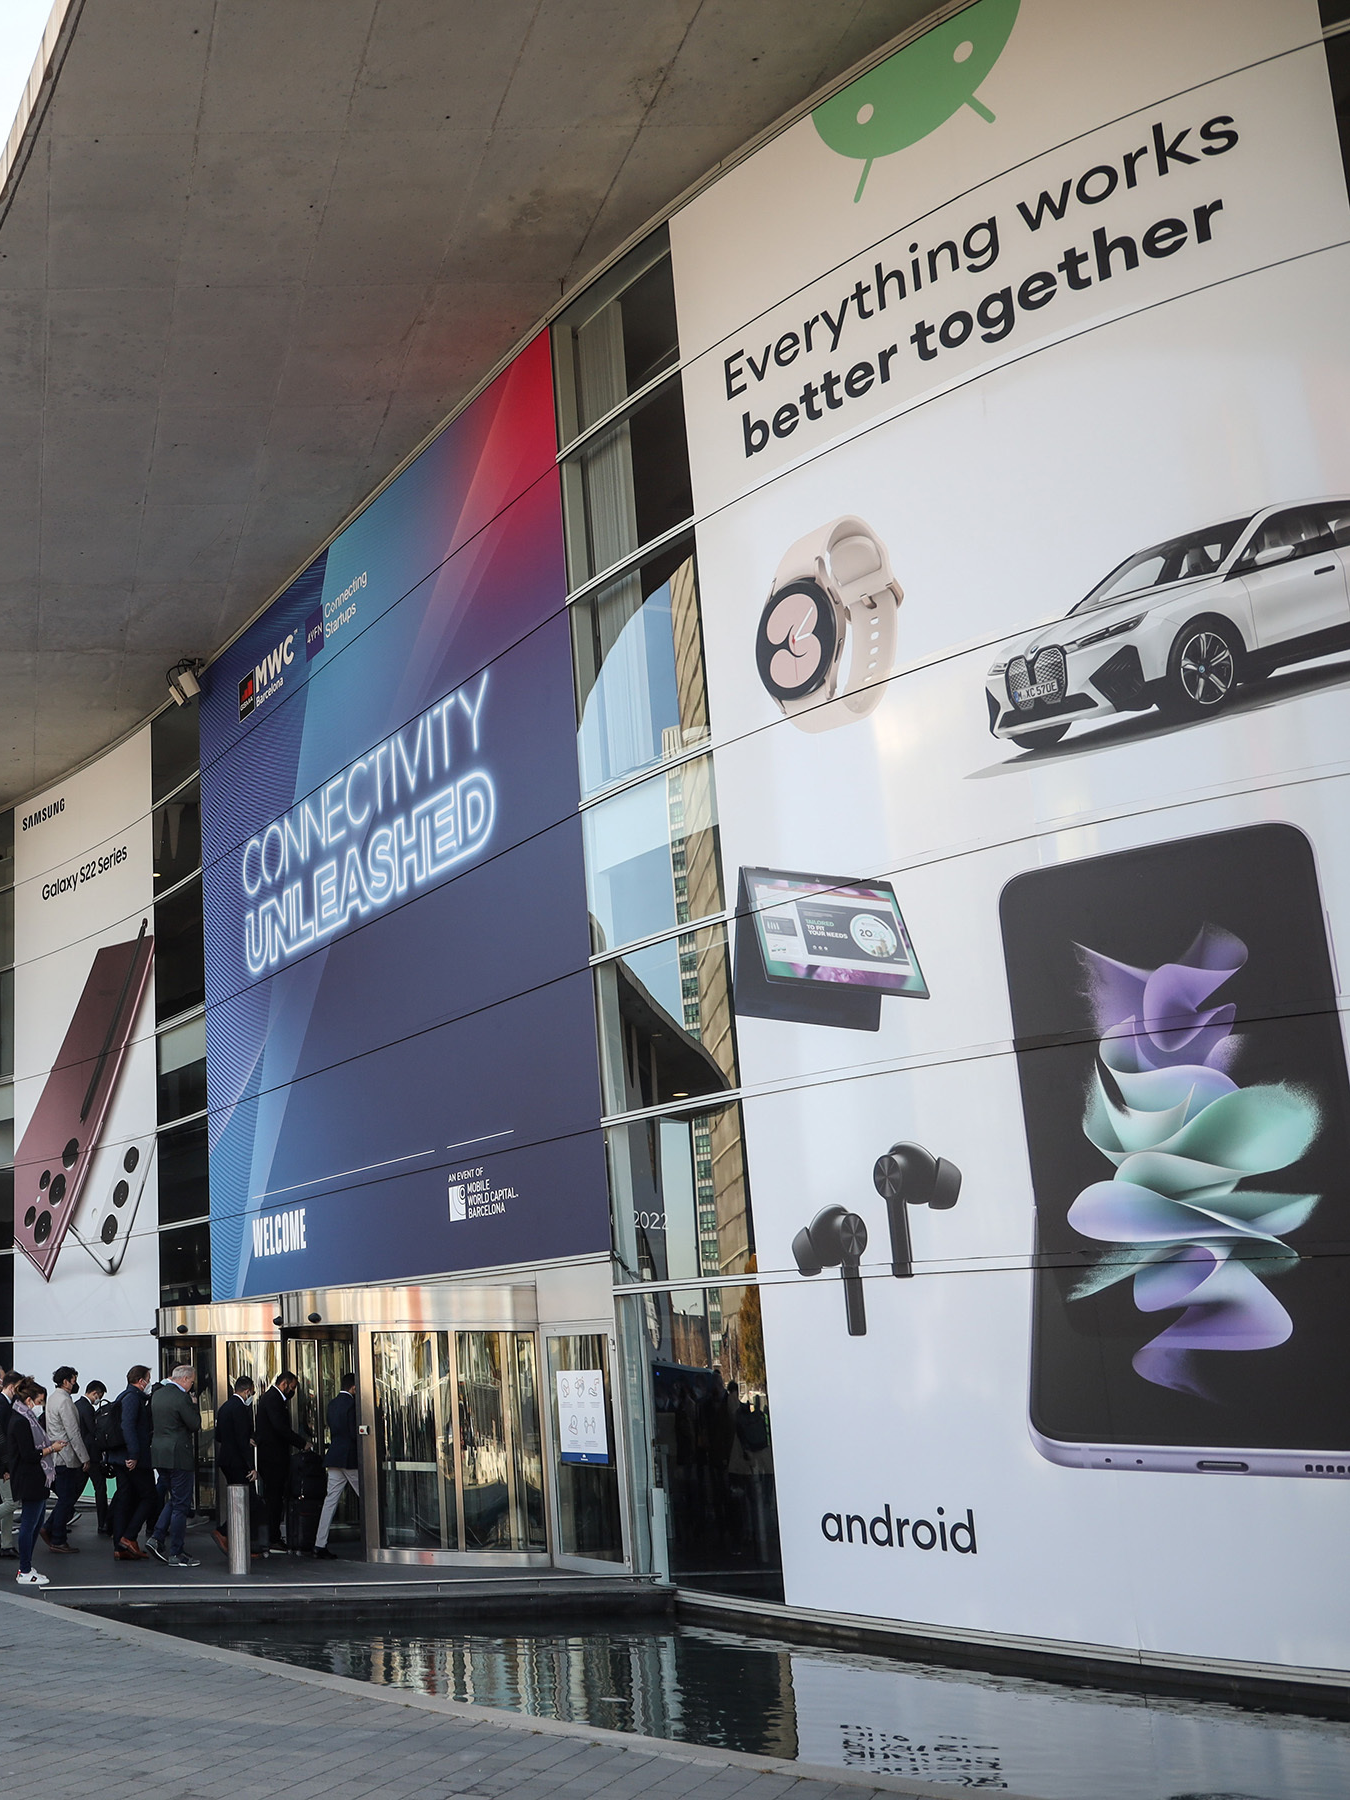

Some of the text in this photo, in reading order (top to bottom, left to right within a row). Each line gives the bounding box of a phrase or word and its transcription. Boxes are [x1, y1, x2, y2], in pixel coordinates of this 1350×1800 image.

[725, 114, 1239, 401] Everything works
[742, 198, 1224, 458] better together
[324, 571, 368, 618] Connecting
[307, 621, 323, 644] 4YFN
[325, 603, 357, 638] Startups
[256, 677, 284, 707] Barcelona
[1026, 687, 1036, 698] XC
[242, 670, 489, 895] CONNECTIVITY
[22, 798, 66, 831] SAMSUNG
[42, 846, 128, 900] Galaxy S22 Series
[244, 771, 495, 973] UNLEASHED
[805, 919, 835, 927] TAILORED
[808, 929, 848, 939] YOUR NEEDS
[448, 1167, 484, 1182] AN EVENT OF
[467, 1179, 490, 1194] MOBILE
[467, 1192, 490, 1206] WORLD
[468, 1202, 506, 1219] BARCELONA
[252, 1208, 307, 1258] WELCOME
[633, 1211, 670, 1230] 2022
[821, 1503, 978, 1555] android
